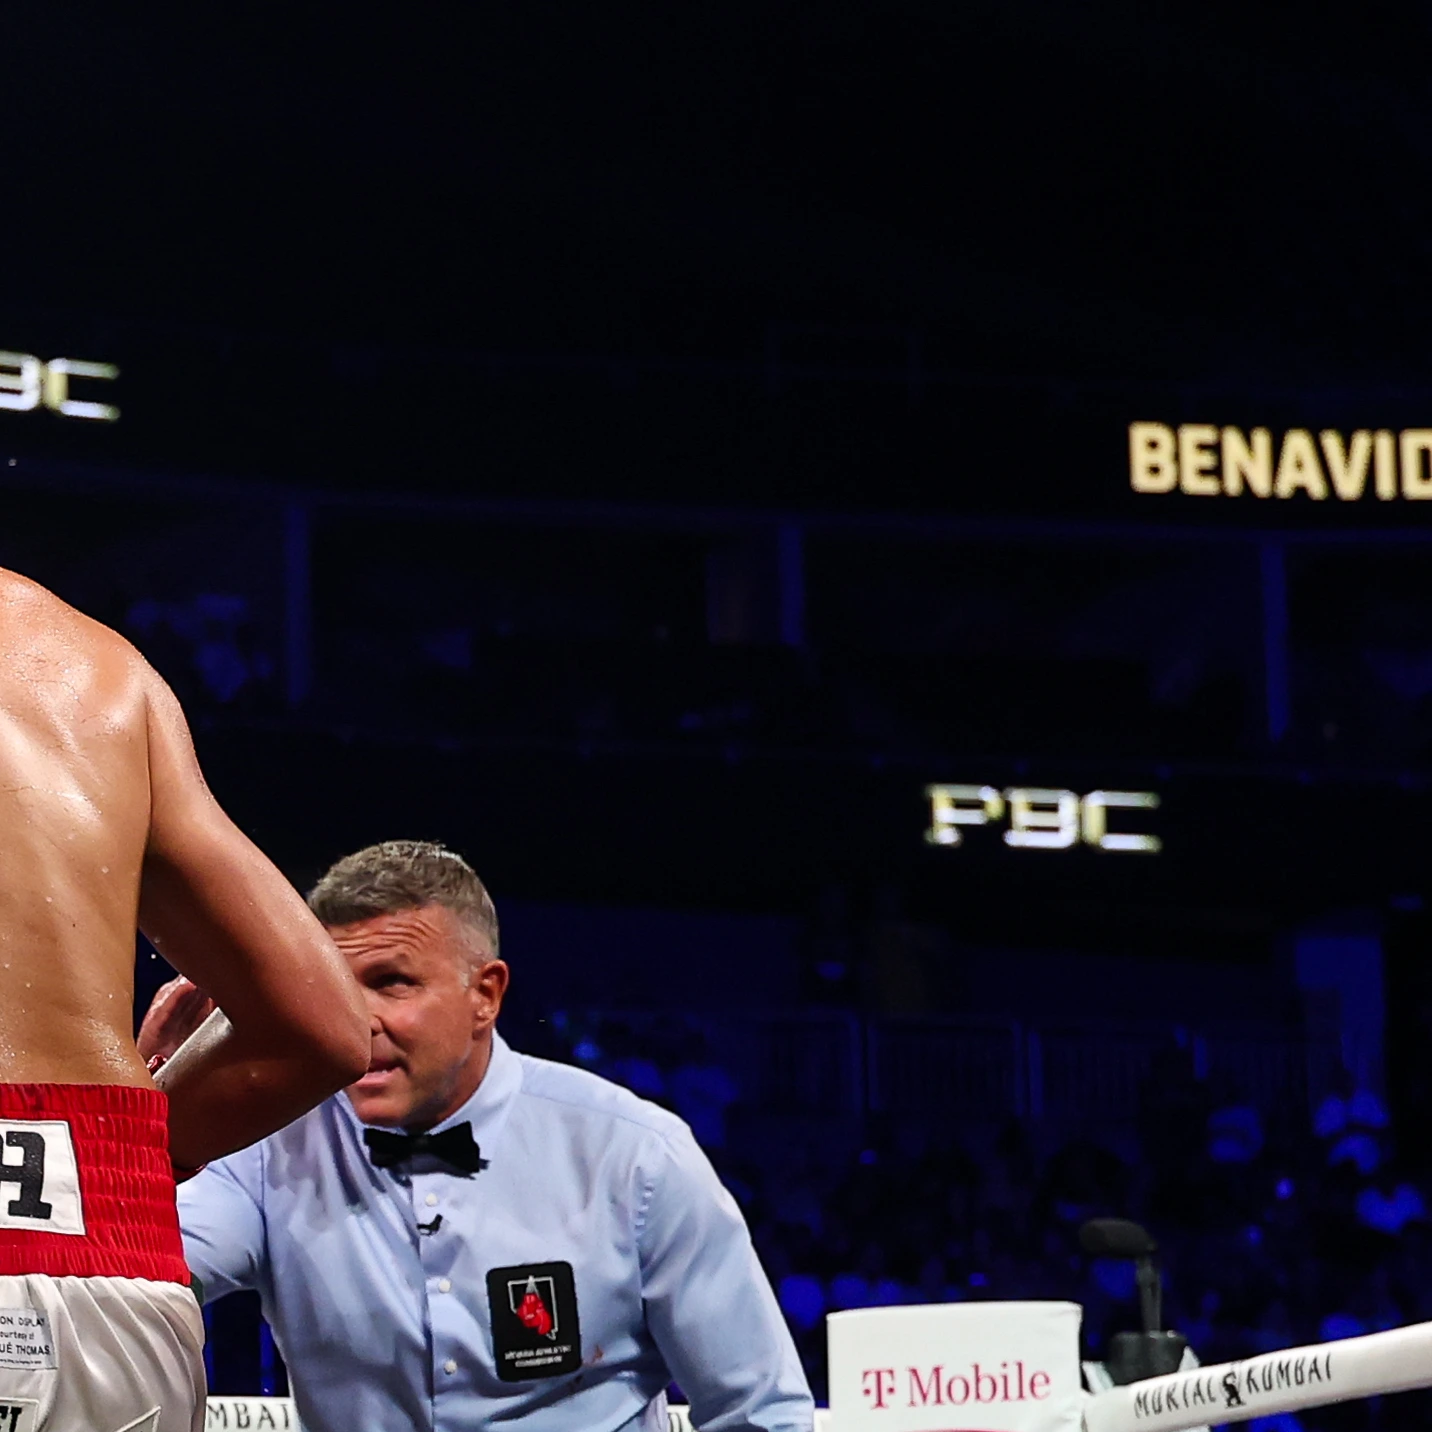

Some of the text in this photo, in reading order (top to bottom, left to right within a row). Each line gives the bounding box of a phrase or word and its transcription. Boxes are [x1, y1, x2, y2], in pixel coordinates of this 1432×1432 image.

[1128, 421, 1432, 500] BENAVID
[924, 783, 1162, 853] PBC
[0, 1316, 14, 1325] ON
[16, 1344, 51, 1356] THOMAS
[907, 1361, 1051, 1407] Mobile
[207, 1403, 289, 1430] MBAT
